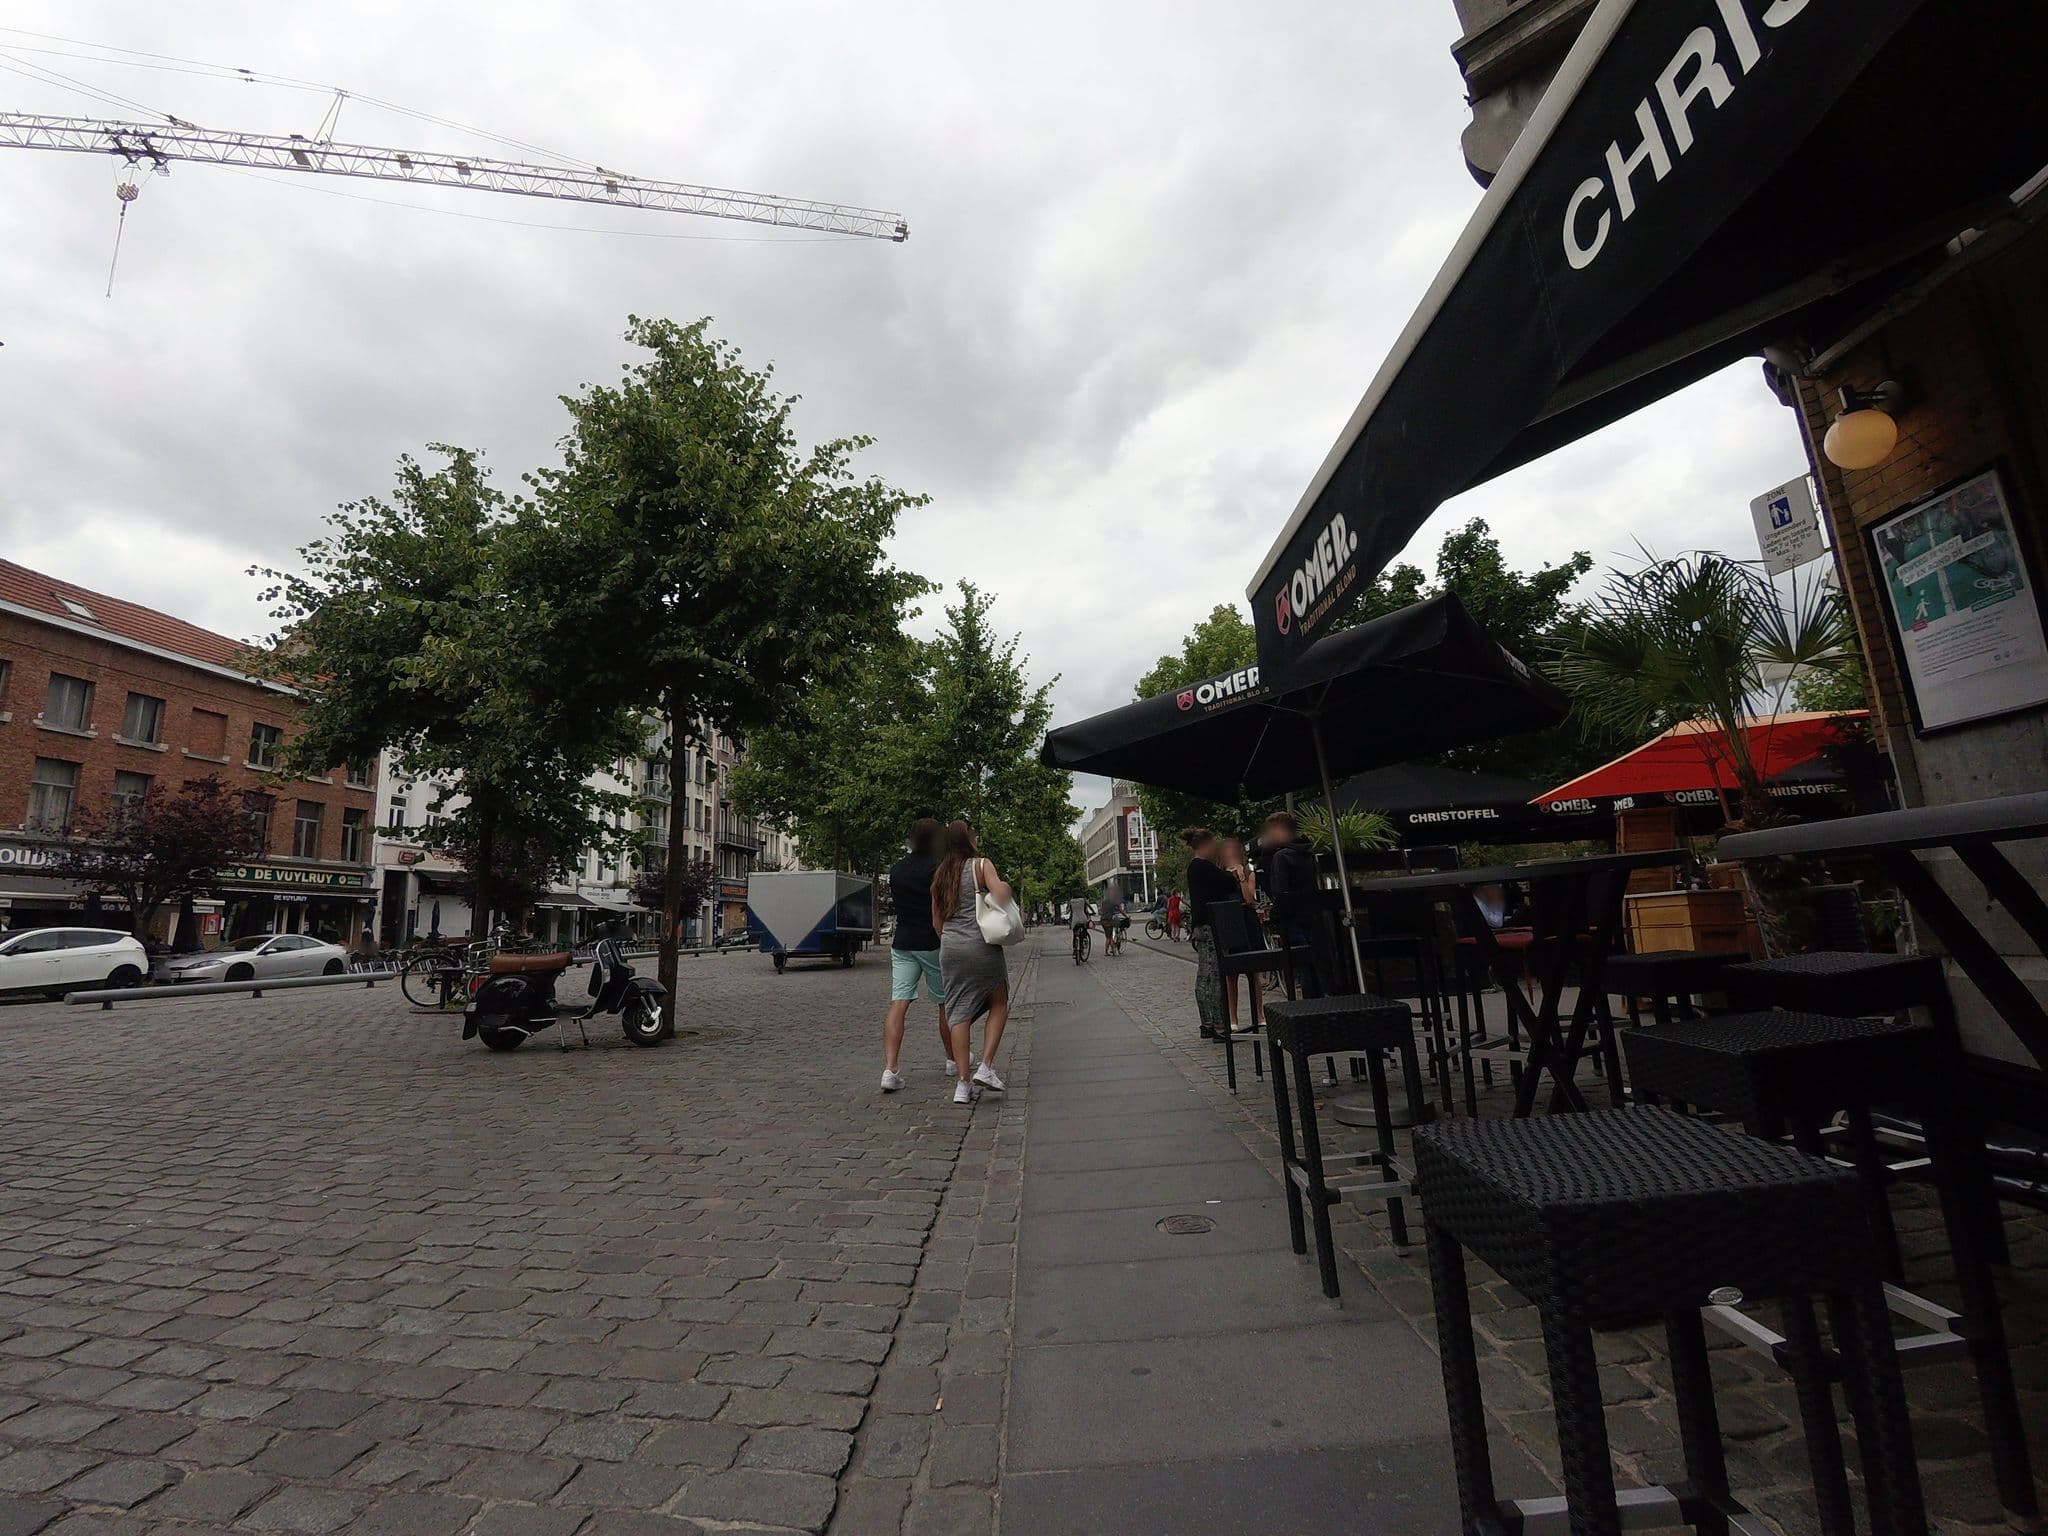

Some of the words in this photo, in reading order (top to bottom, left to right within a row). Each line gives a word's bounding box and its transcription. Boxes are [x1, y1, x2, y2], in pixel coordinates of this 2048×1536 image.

[1767, 487, 1786, 501] ZONE
[1409, 808, 1499, 824] CHRISTOFFEL
[254, 868, 273, 880] DE
[276, 870, 334, 884] VUYLRUY
